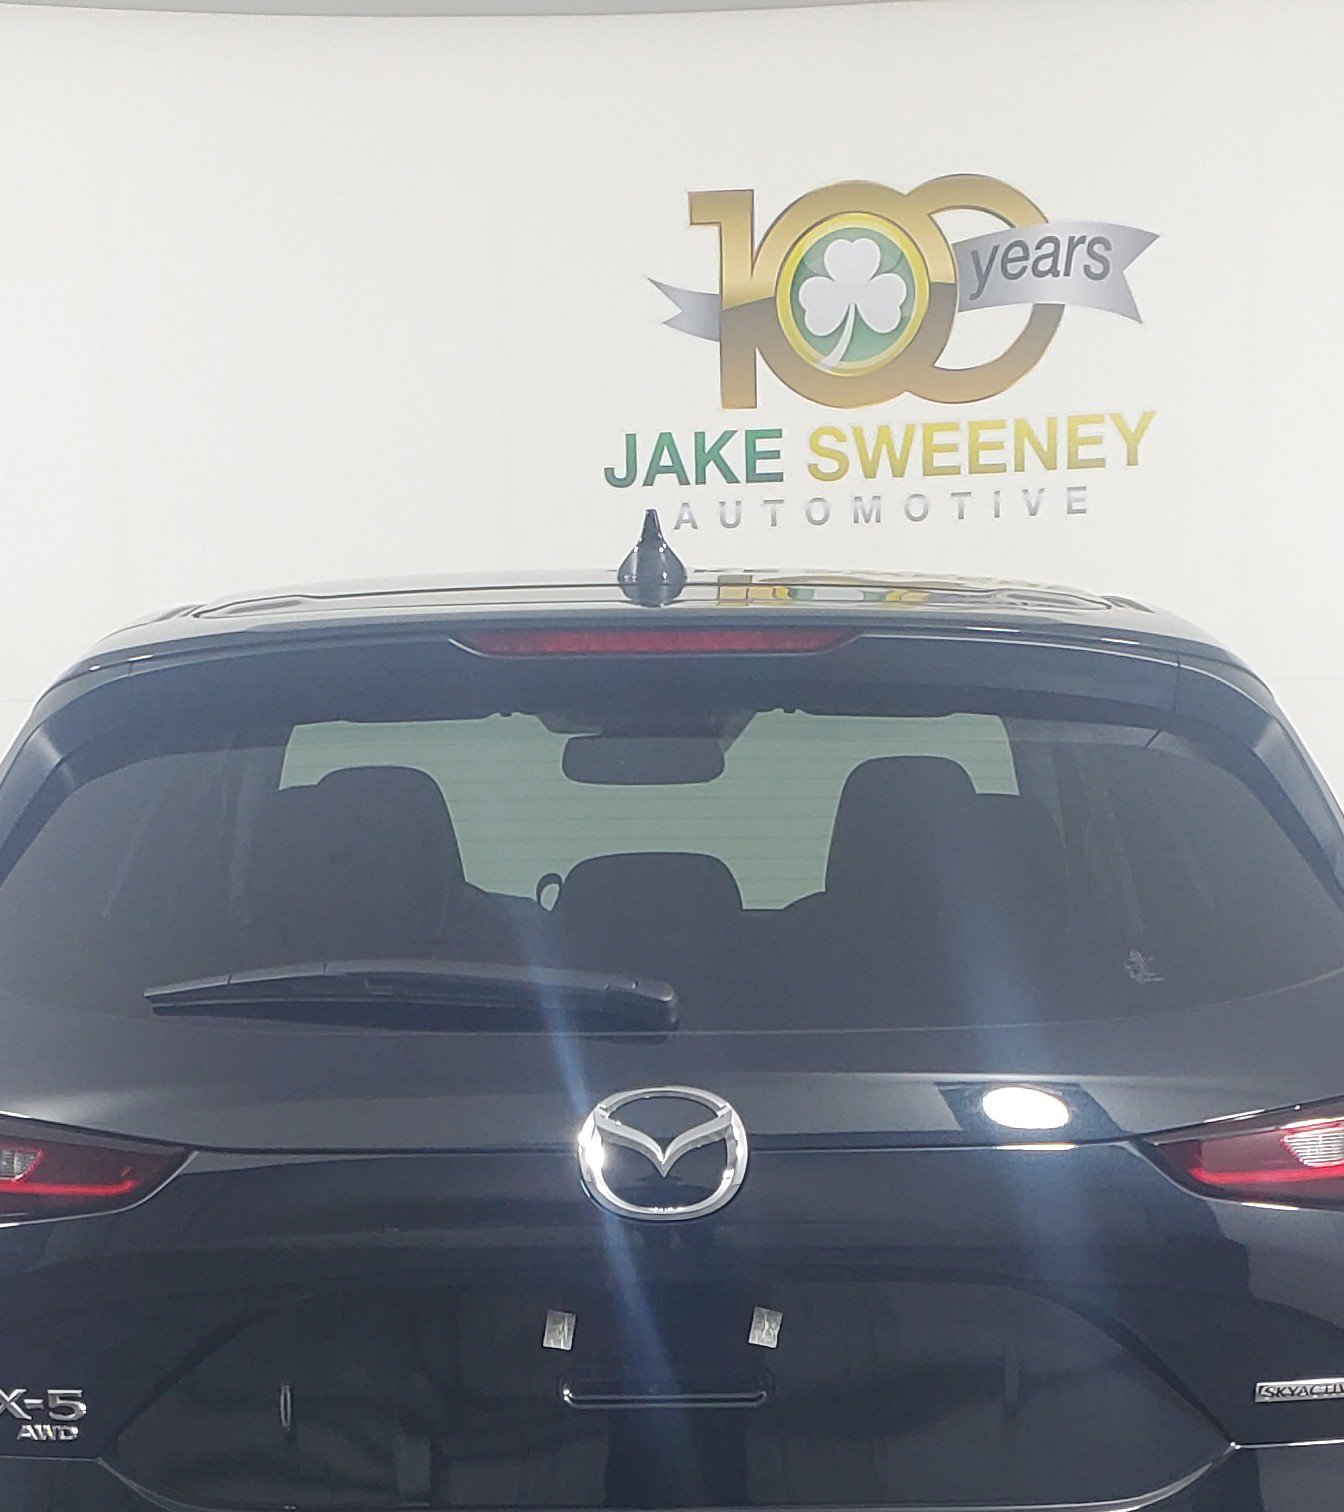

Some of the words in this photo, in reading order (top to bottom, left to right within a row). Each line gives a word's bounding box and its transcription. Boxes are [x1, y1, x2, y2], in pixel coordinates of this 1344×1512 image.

[687, 173, 1065, 410] 100
[970, 233, 1113, 299] years
[603, 427, 785, 489] JAKE
[807, 411, 1157, 483] SWEENEY
[673, 485, 1088, 531] AUTOMOTIVE
[17, 1424, 79, 1441] AWD
